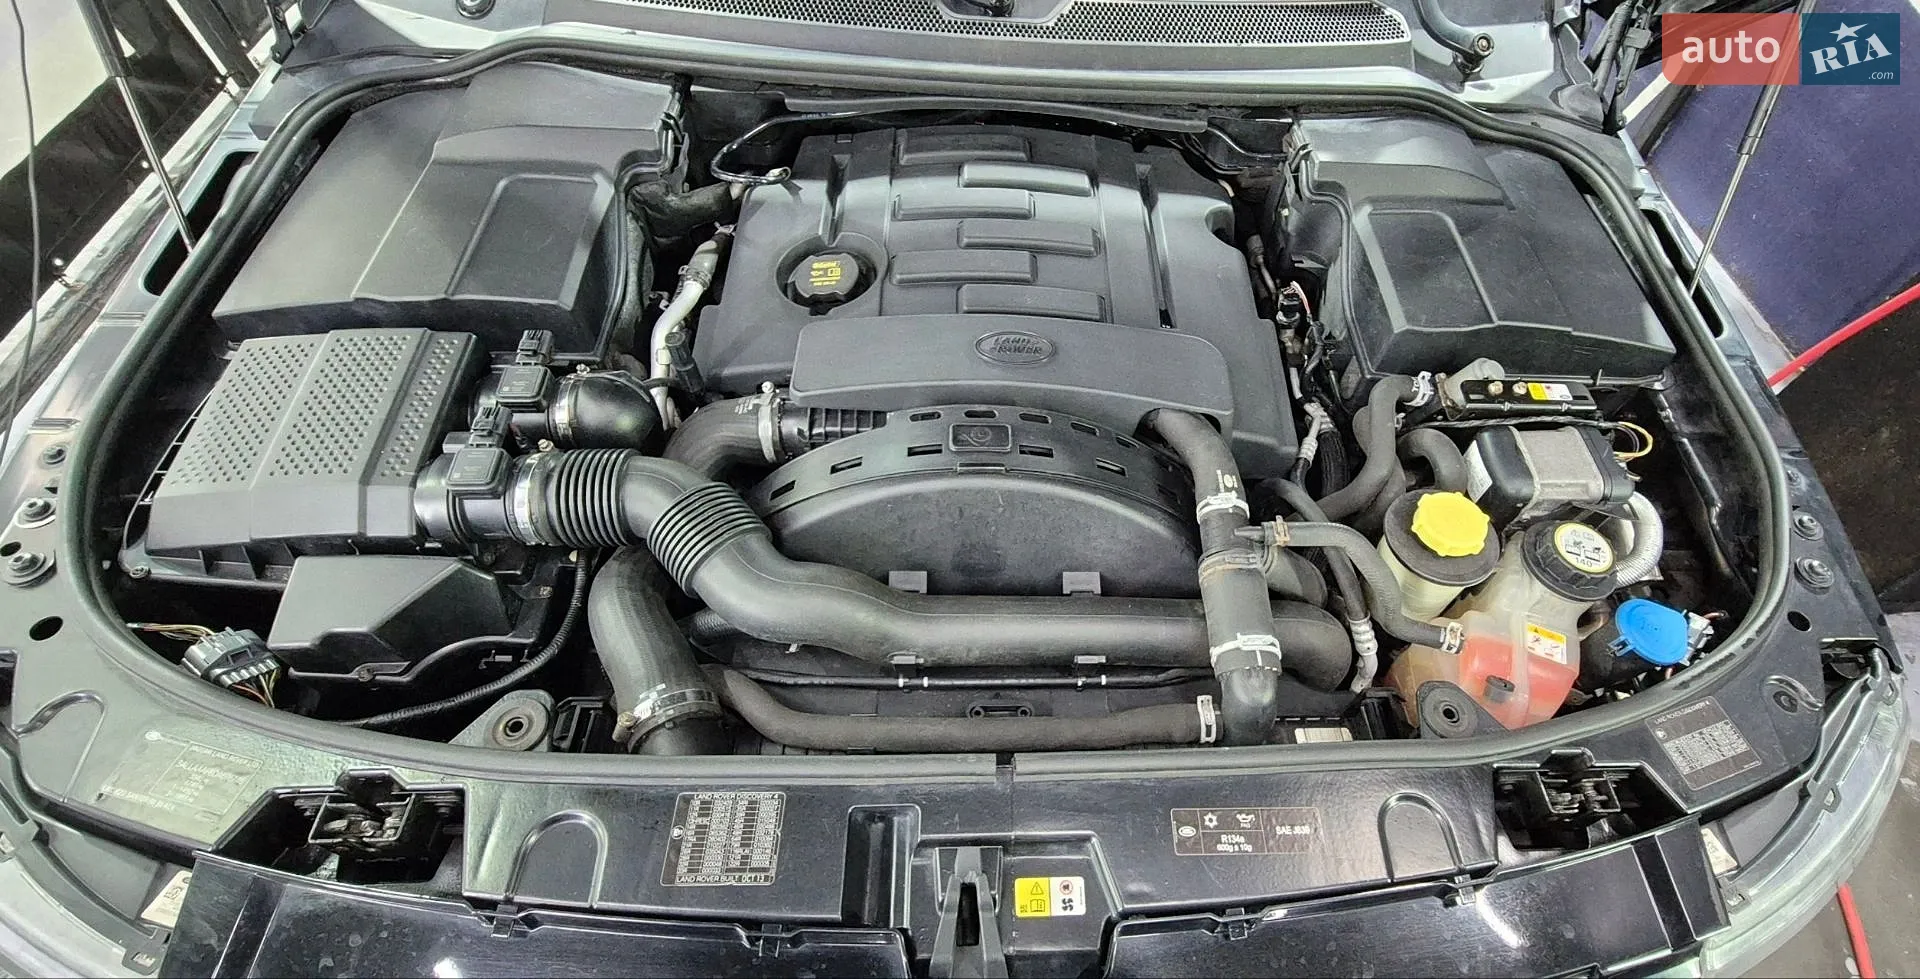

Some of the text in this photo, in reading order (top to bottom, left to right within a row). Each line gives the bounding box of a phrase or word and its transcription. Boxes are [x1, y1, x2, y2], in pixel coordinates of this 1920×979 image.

[1575, 557, 1593, 568] 140
[1275, 825, 1292, 835] SAE
[1221, 834, 1245, 843] R134a
[677, 875, 696, 883] LAND
[696, 875, 720, 883] ROVER
[742, 874, 757, 882] OCT
[757, 874, 765, 882] 13
